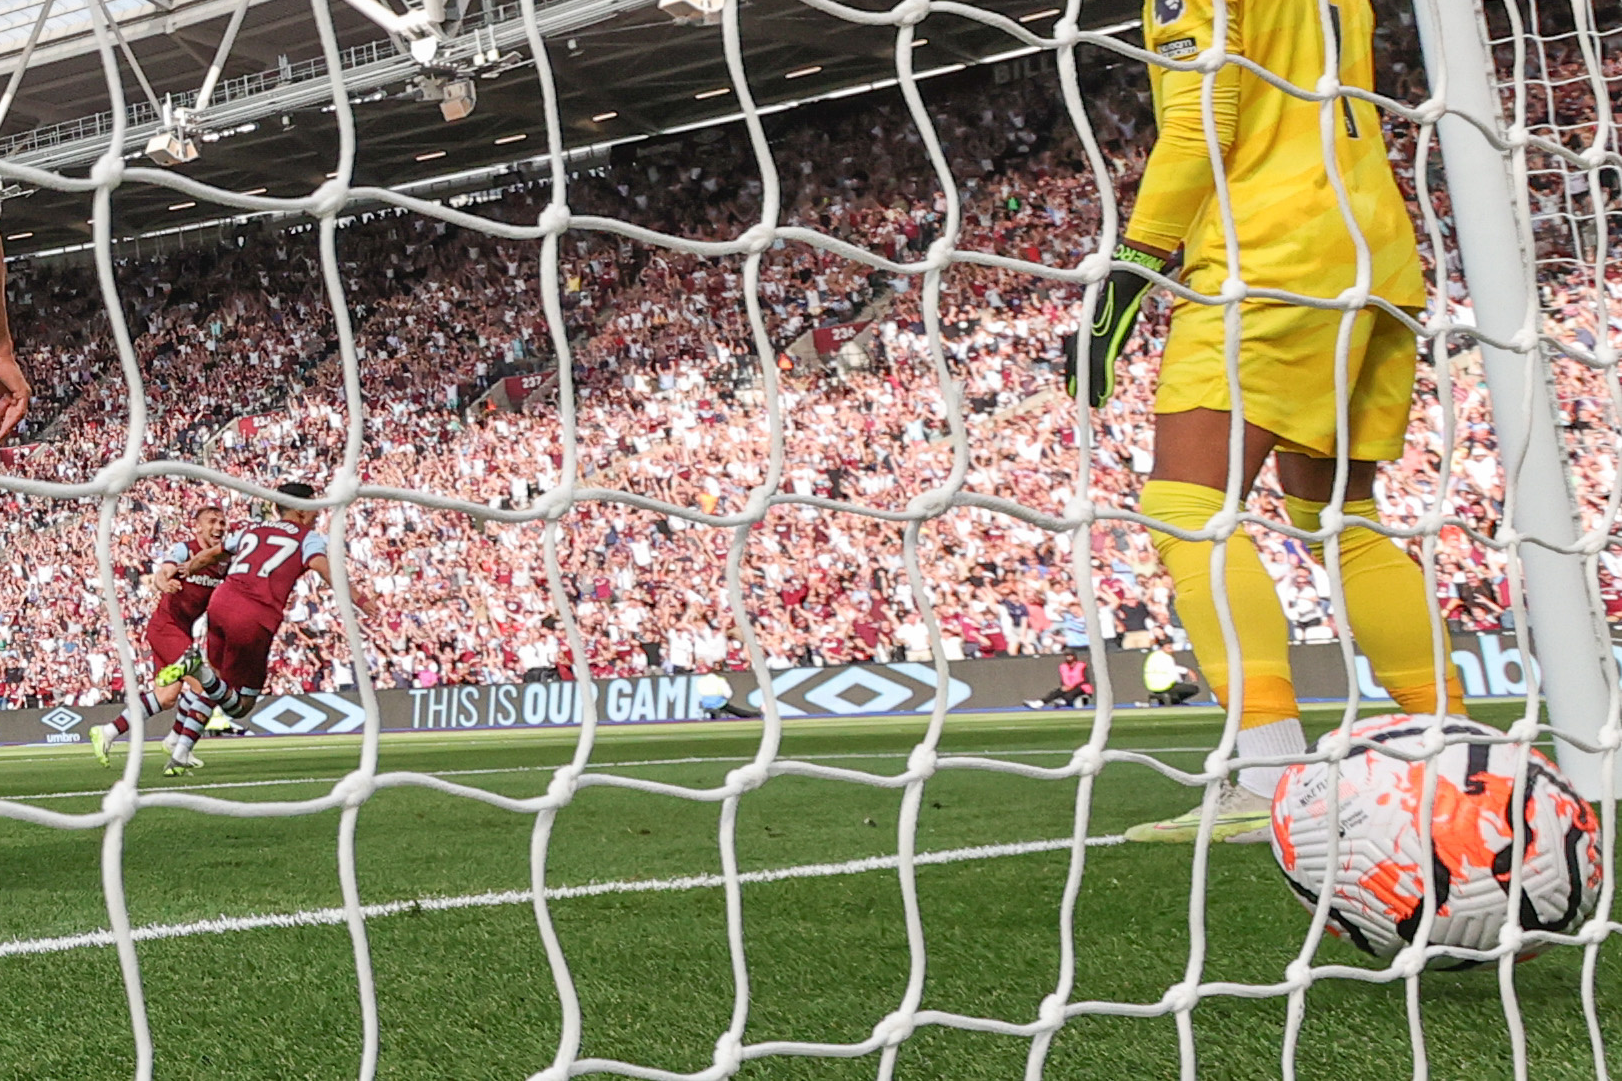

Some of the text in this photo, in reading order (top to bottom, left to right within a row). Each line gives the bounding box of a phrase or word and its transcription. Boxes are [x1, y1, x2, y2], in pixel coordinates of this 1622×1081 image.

[521, 375, 542, 389] 237
[227, 532, 299, 578] 27
[409, 687, 479, 729] THIS
[490, 684, 518, 727] IS
[46, 732, 80, 743] umbro
